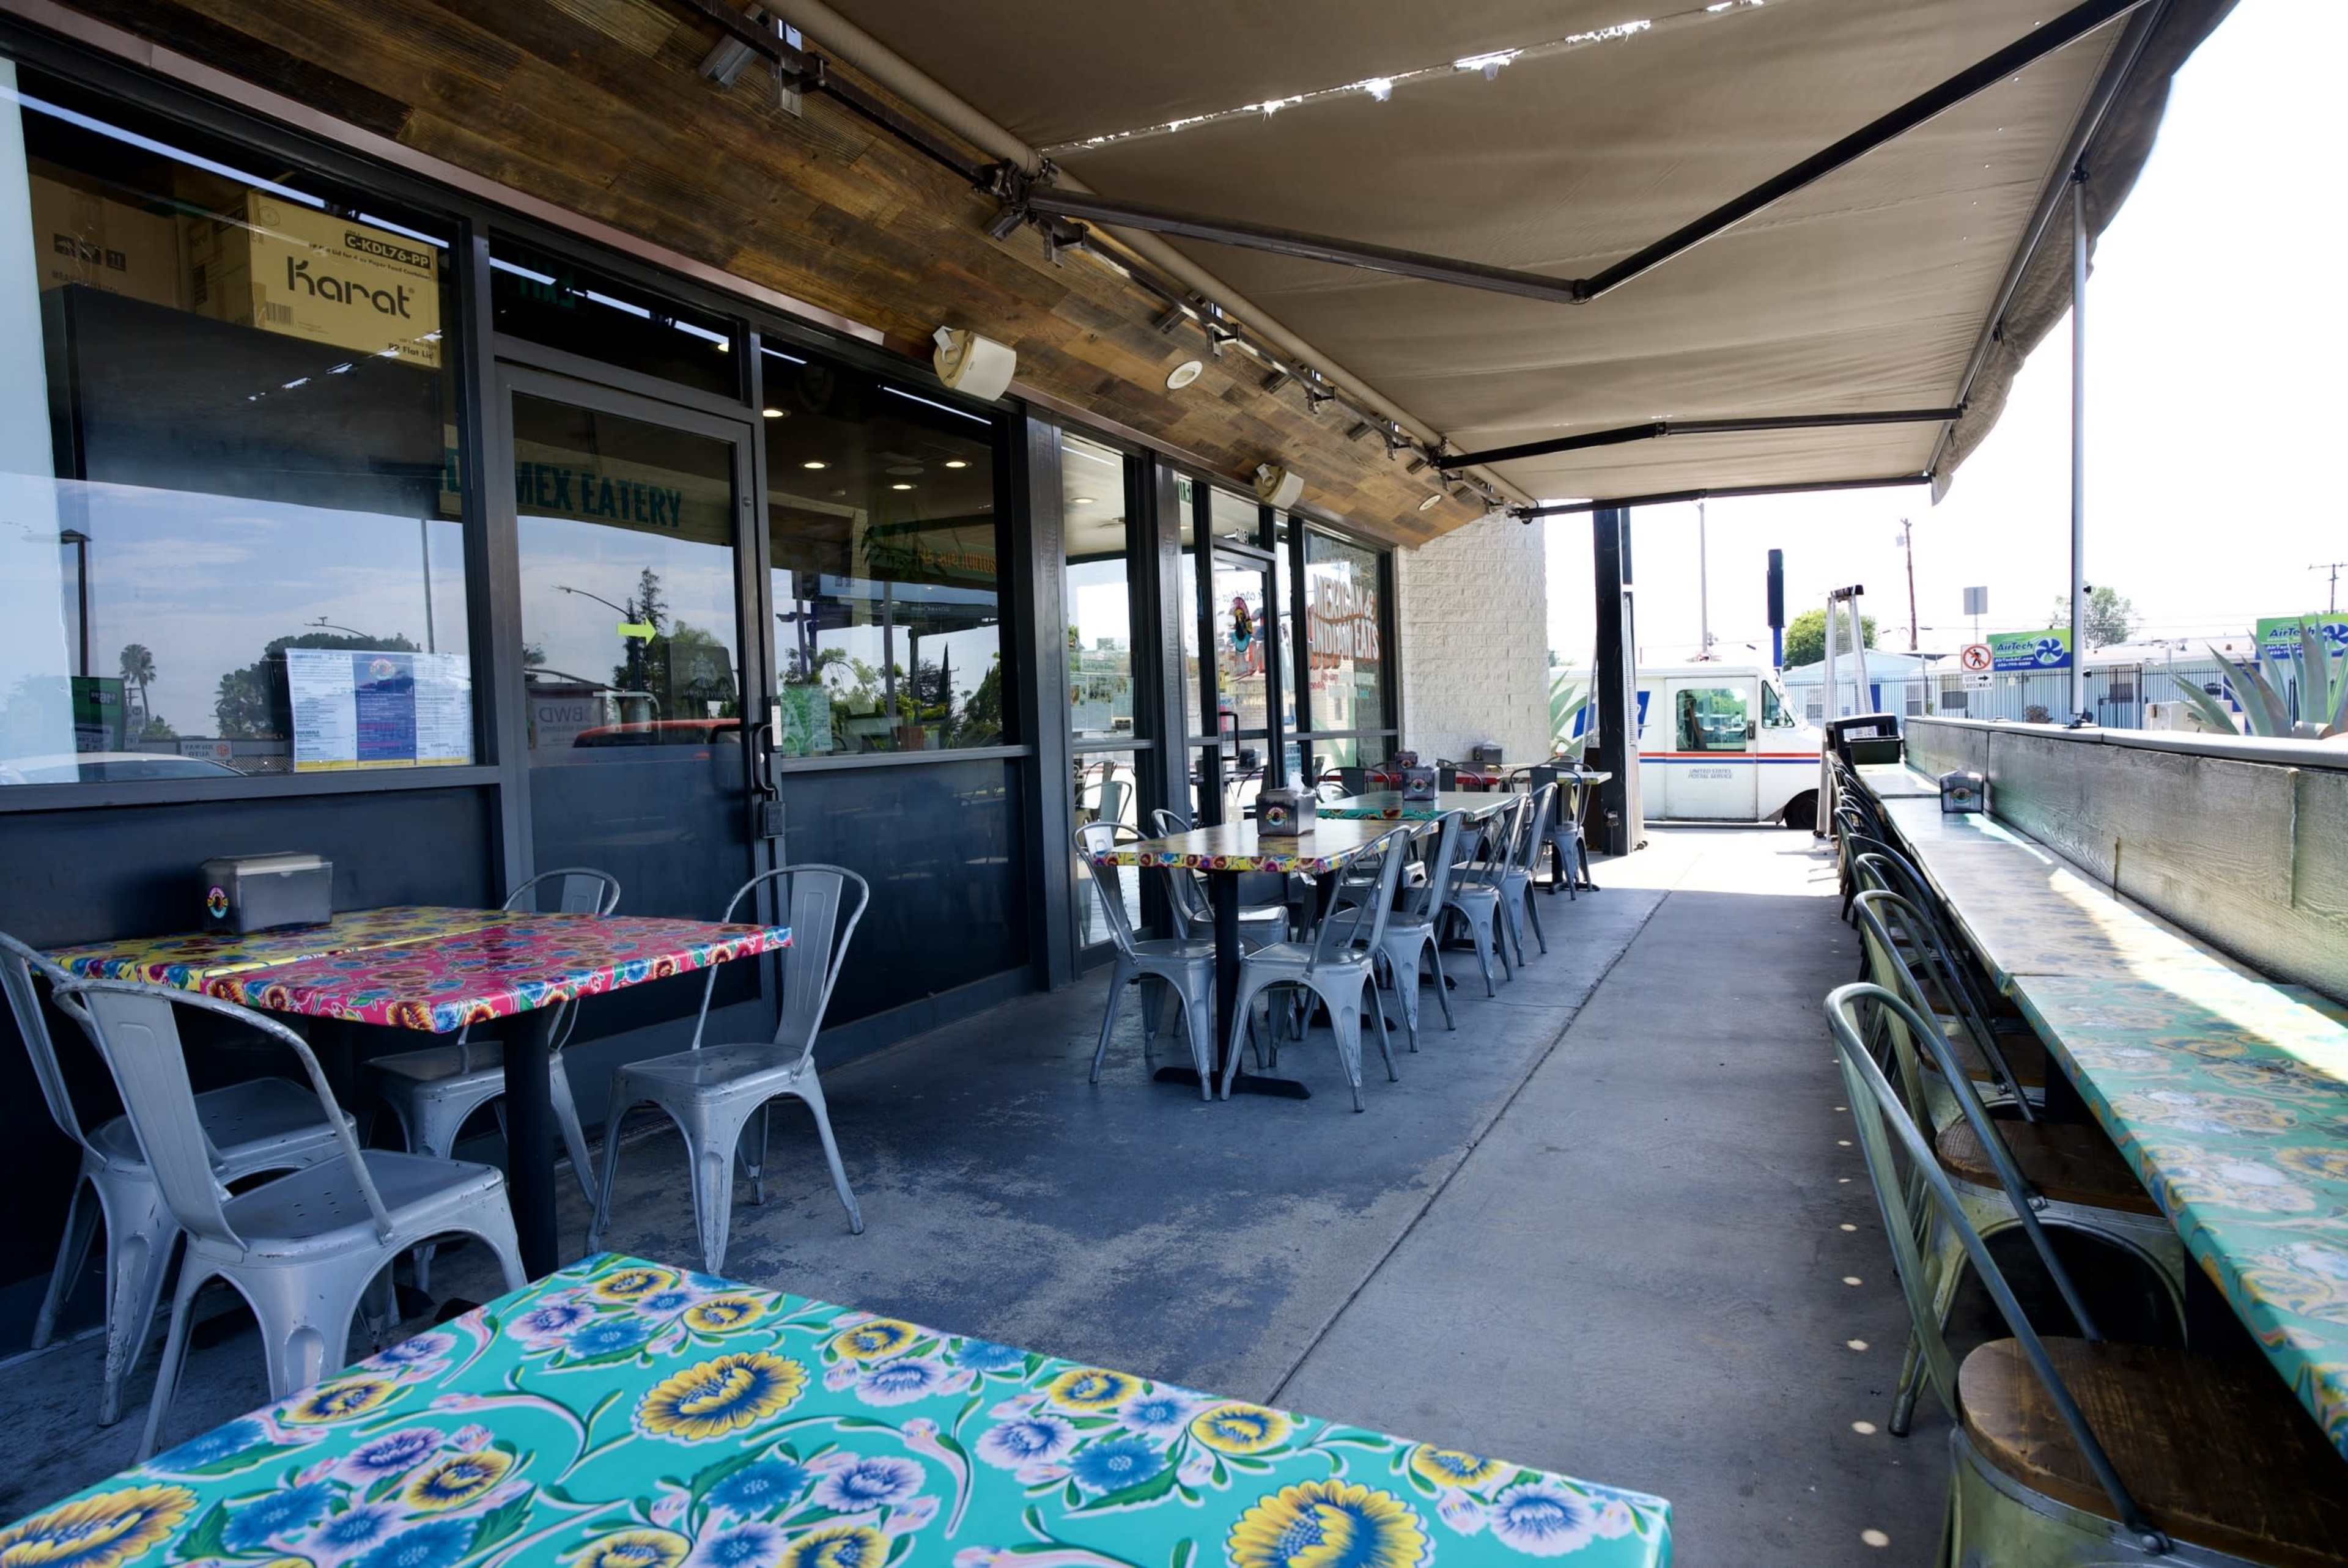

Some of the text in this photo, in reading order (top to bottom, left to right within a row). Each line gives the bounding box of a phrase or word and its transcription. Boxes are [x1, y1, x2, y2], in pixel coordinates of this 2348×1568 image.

[347, 237, 429, 267] C-KDL76-PP
[287, 256, 410, 319] Karat
[580, 473, 682, 528] EATERY
[1313, 573, 1364, 619] MEXICAN
[1364, 589, 1377, 622] &
[1312, 613, 1380, 661] INDIAN EATS
[1996, 642, 2034, 652] AirTech
